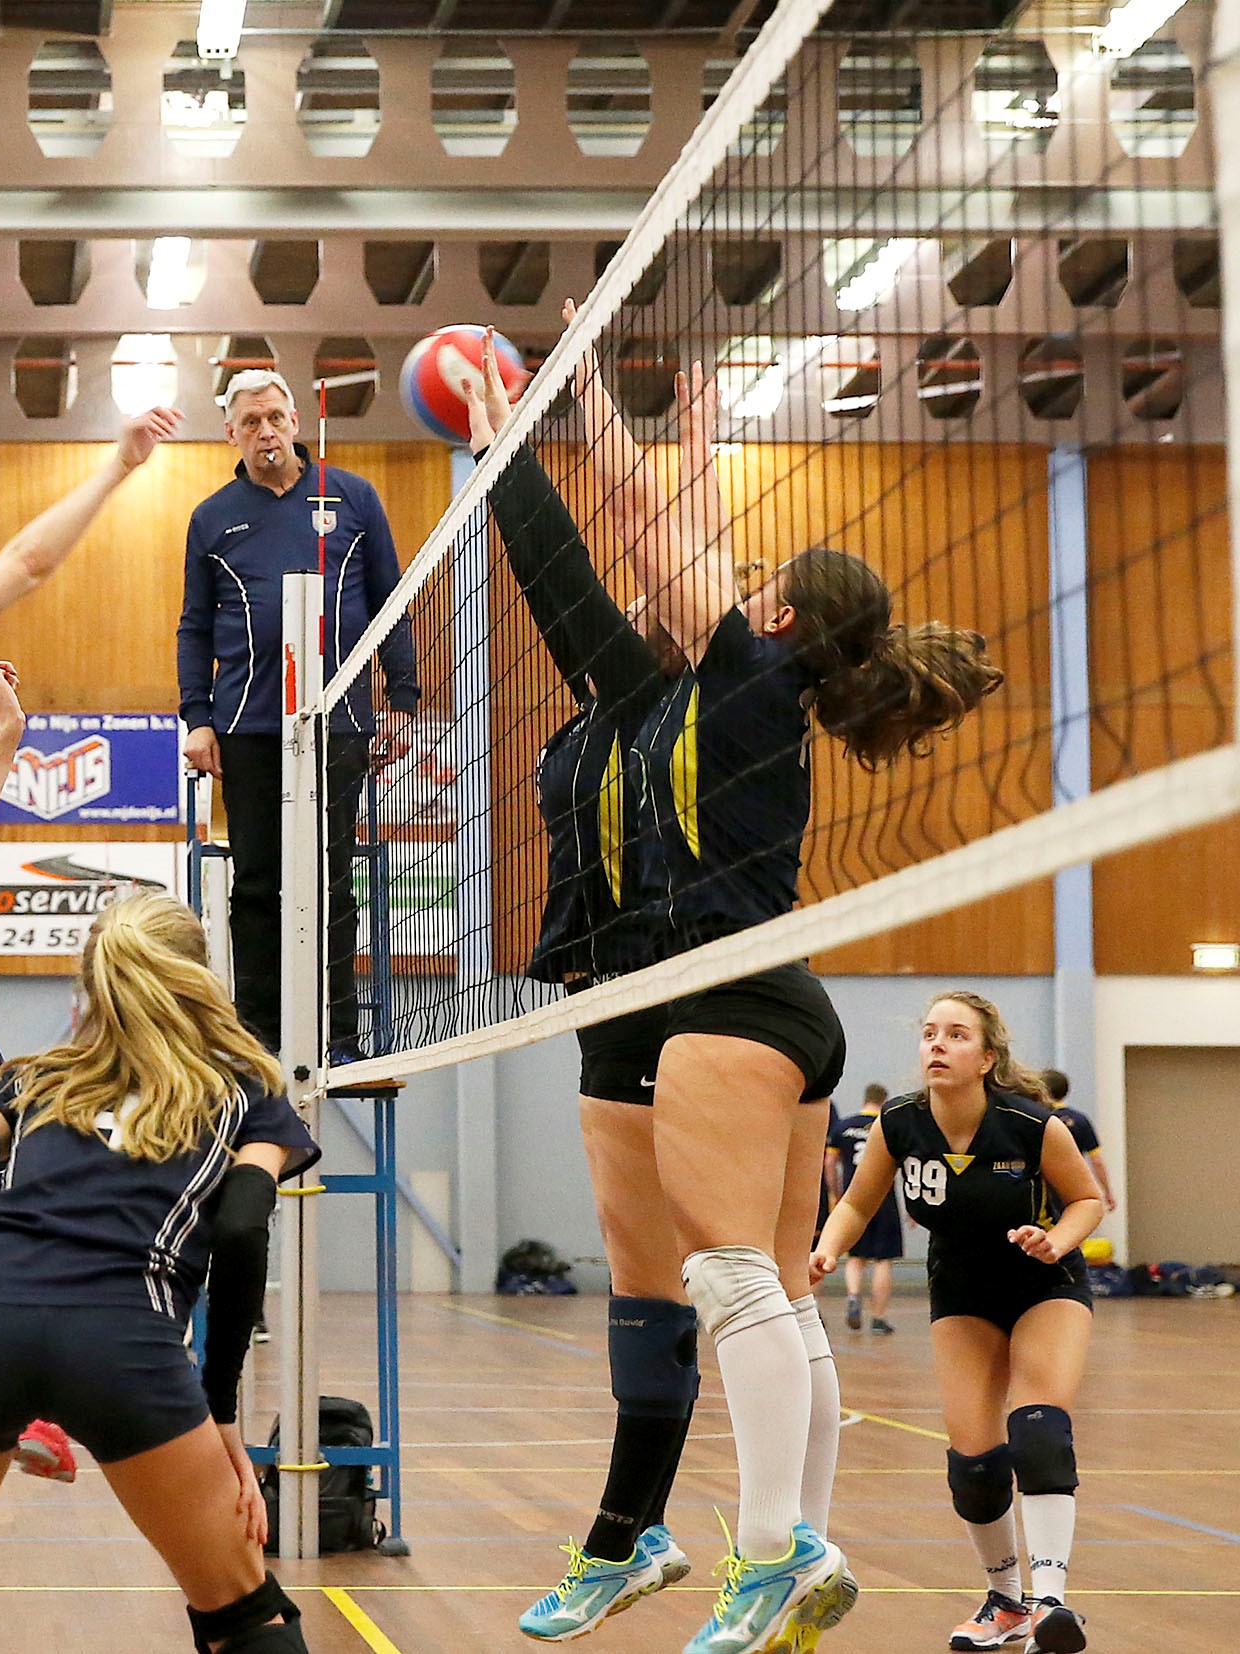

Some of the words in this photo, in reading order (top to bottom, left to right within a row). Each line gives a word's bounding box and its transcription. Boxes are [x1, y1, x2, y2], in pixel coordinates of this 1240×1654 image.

[27, 715, 48, 731] de
[80, 718, 101, 731] en
[102, 714, 149, 731] Zonen
[903, 1156, 947, 1206] 99
